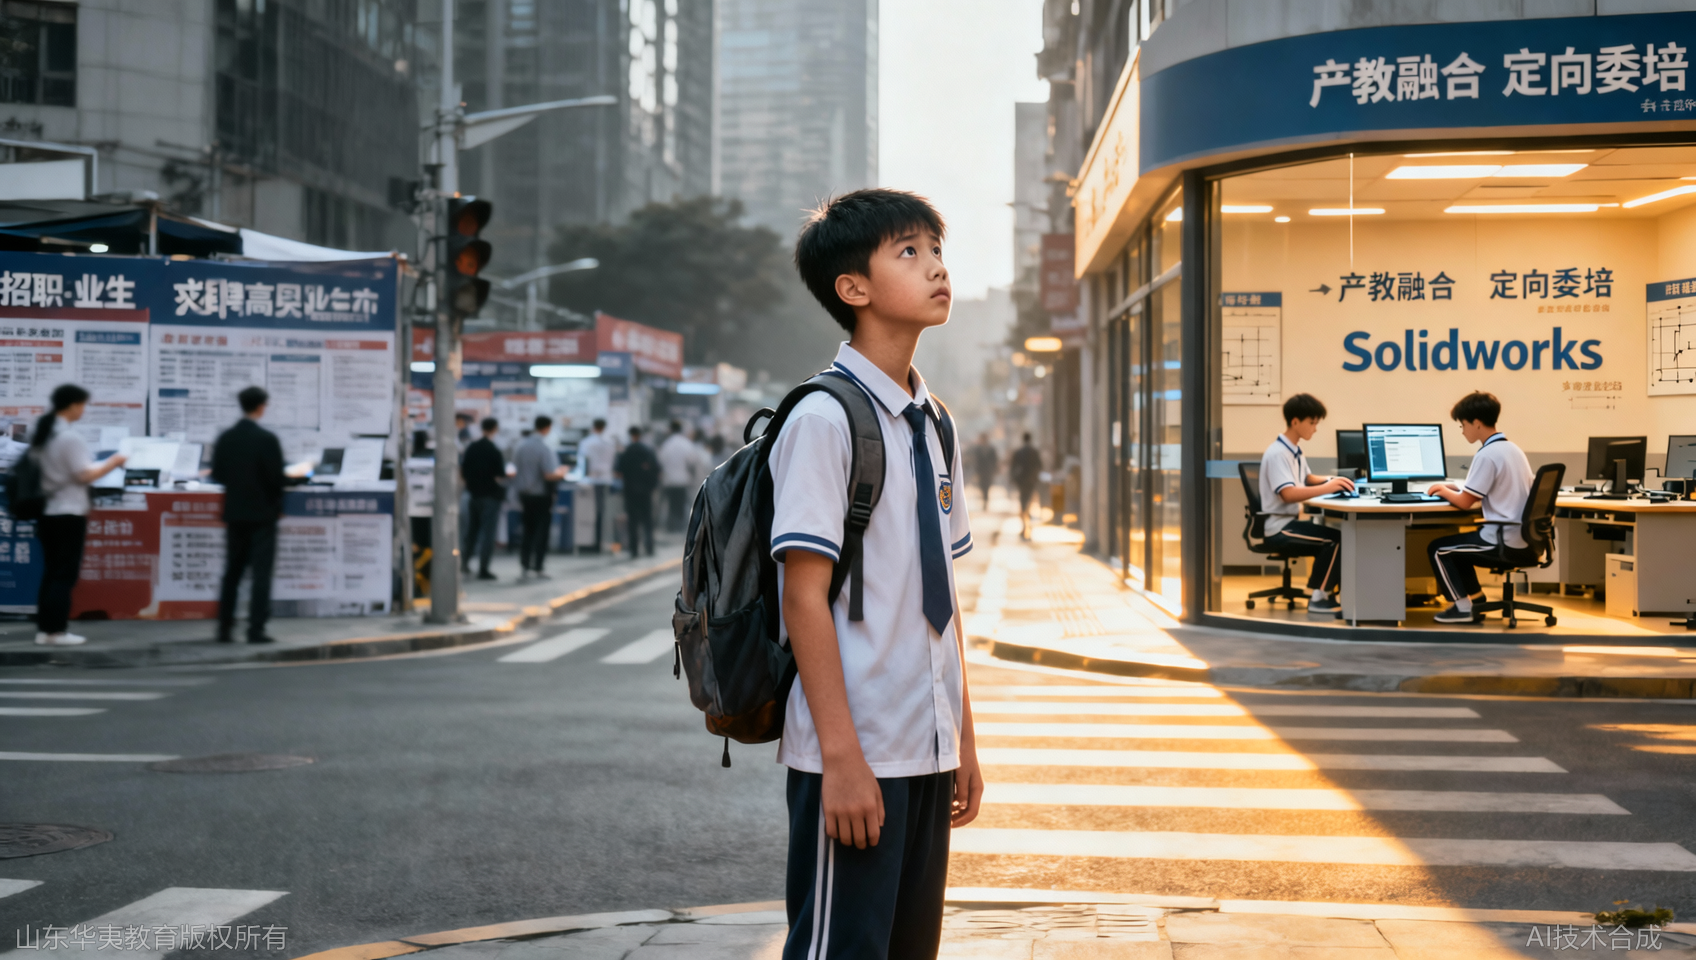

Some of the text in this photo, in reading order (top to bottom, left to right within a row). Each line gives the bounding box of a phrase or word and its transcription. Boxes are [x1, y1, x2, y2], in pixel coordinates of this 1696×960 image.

[1309, 41, 1690, 108] 产教融合 定向委培
[1338, 267, 1614, 302] 产教融合 定向委培
[1342, 326, 1604, 372] Solidworks
